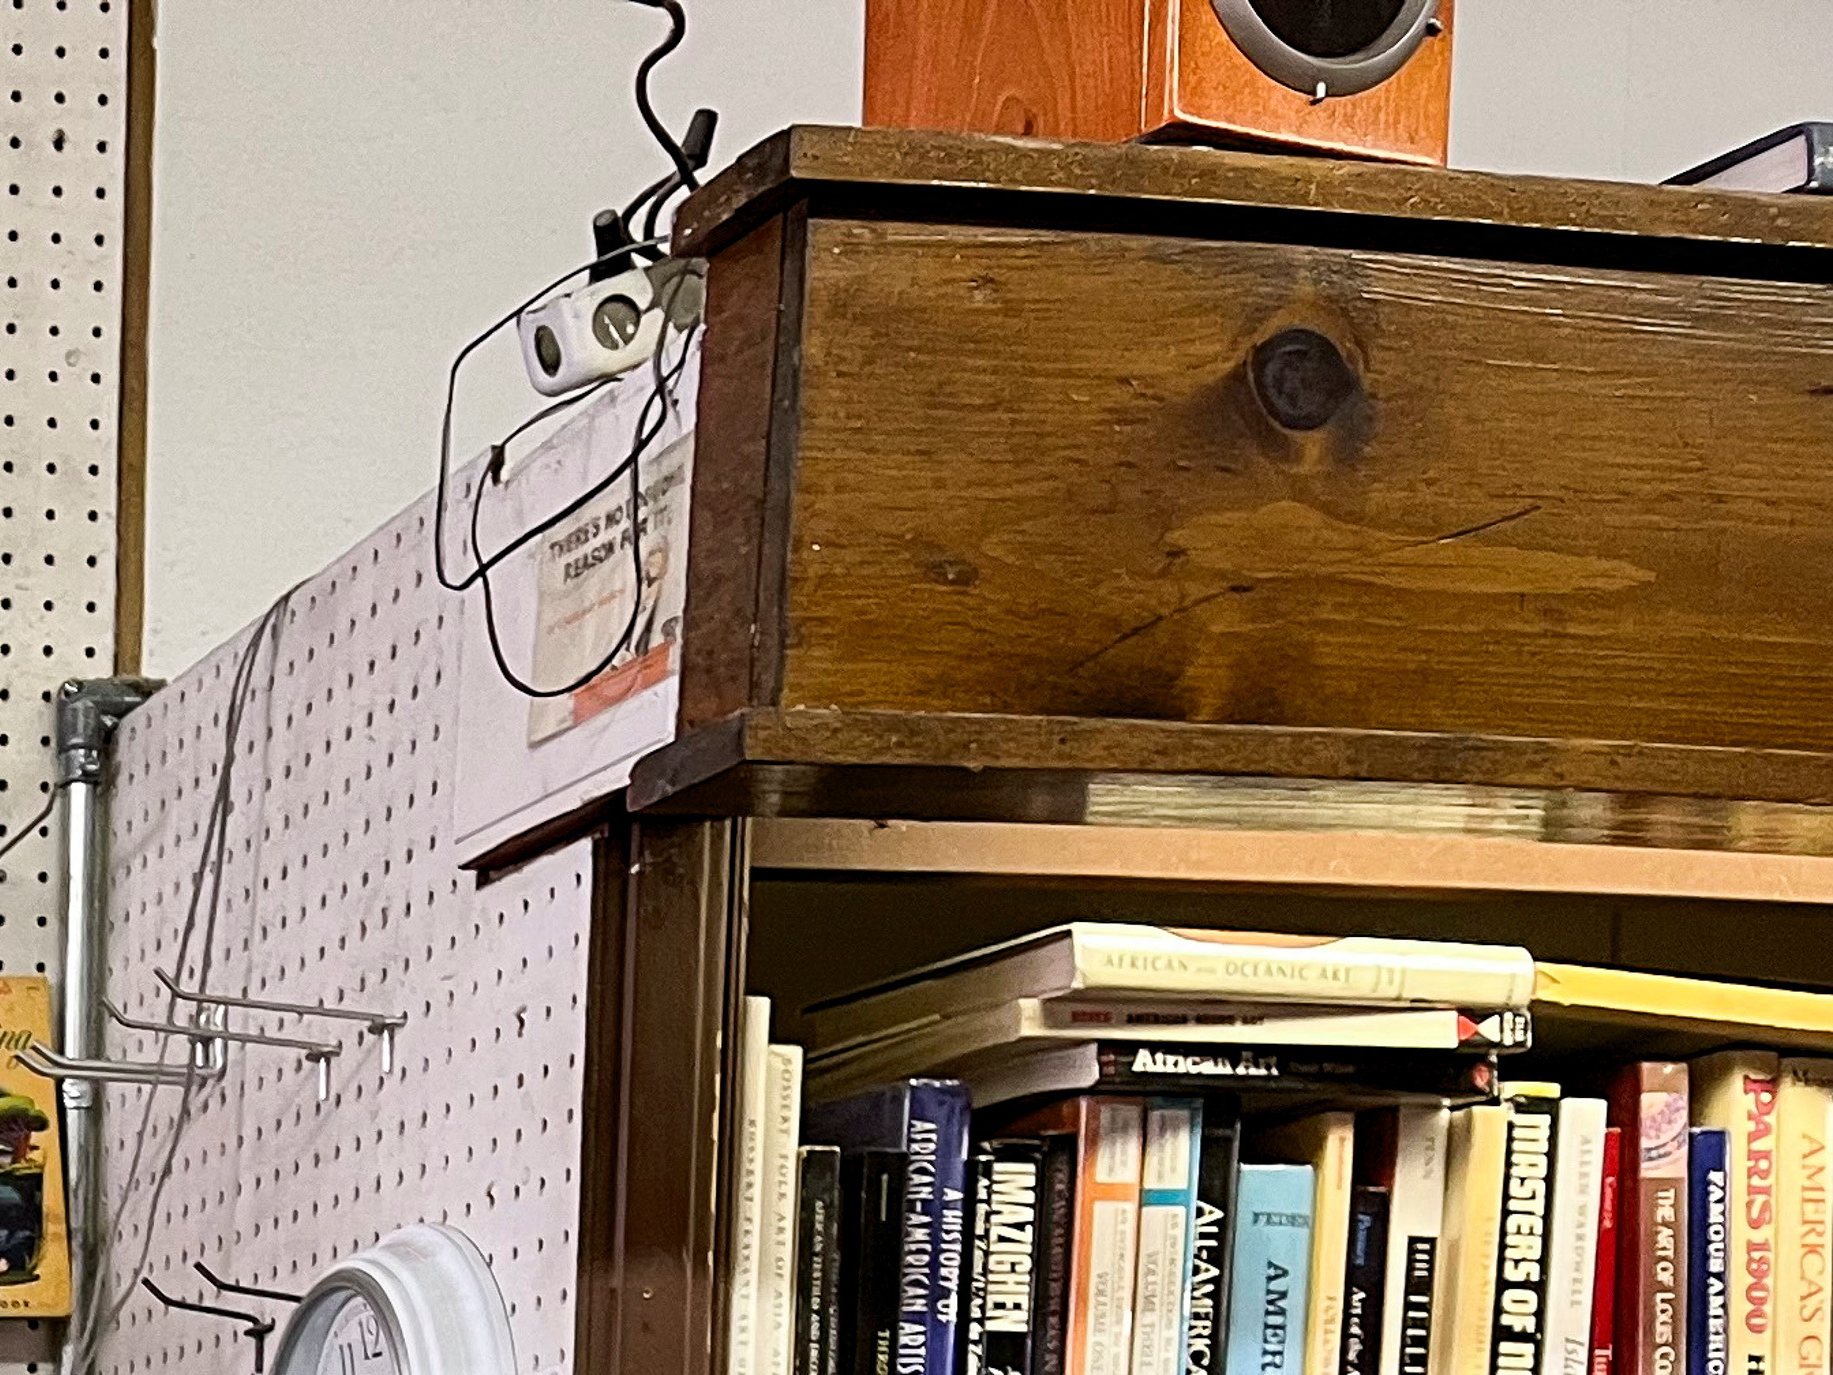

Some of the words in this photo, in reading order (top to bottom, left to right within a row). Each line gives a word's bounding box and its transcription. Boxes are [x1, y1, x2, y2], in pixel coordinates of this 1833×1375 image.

[1133, 1047, 1235, 1076] African
[1235, 1050, 1280, 1077] Art
[1744, 1075, 1778, 1231] PARIS
[900, 1119, 936, 1313] AFRICAN-AMERICAN
[943, 1188, 964, 1201] A
[1501, 1113, 1552, 1282] MASTERS
[1707, 1170, 1724, 1274] FAMOUS
[774, 1210, 788, 1248] ART
[938, 1208, 963, 1292] HISTORY
[984, 1161, 1036, 1333] IMAZIGHEN
[773, 1256, 785, 1282] OF
[1745, 1238, 1773, 1334] 1900
[358, 1315, 384, 1362] 12
[771, 1288, 785, 1331] ASIA
[1499, 1288, 1539, 1335] OF
